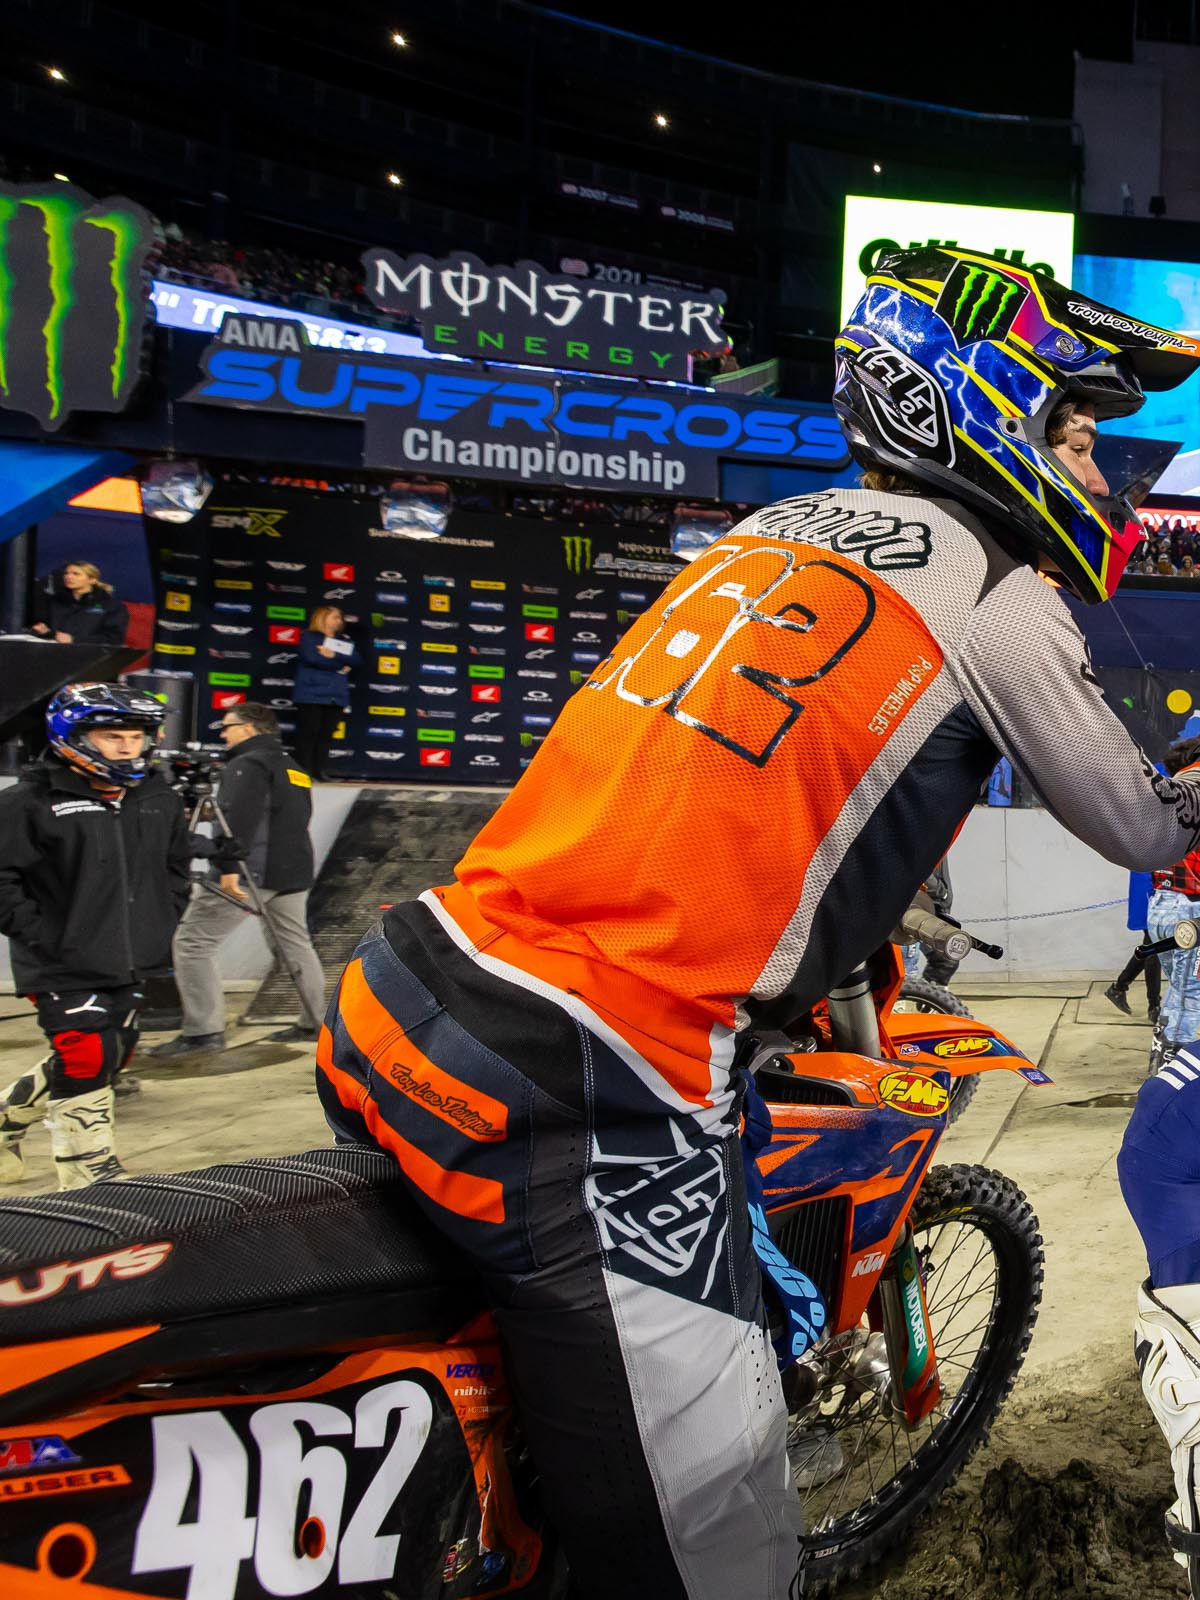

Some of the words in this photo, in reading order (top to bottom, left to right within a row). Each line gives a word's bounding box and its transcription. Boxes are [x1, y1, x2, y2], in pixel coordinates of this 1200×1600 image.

[375, 259, 722, 344] MONSTER
[222, 317, 301, 352] AMA
[434, 324, 672, 369] ENERGY
[199, 349, 850, 461] SUPERCROSS
[402, 427, 686, 490] Championship
[936, 1037, 991, 1057] FMF
[880, 1076, 948, 1107] FMF
[0, 1242, 173, 1307] UTS
[852, 1251, 886, 1278] KTM
[905, 1279, 927, 1357] MOTOREX
[131, 1379, 434, 1600] 462
